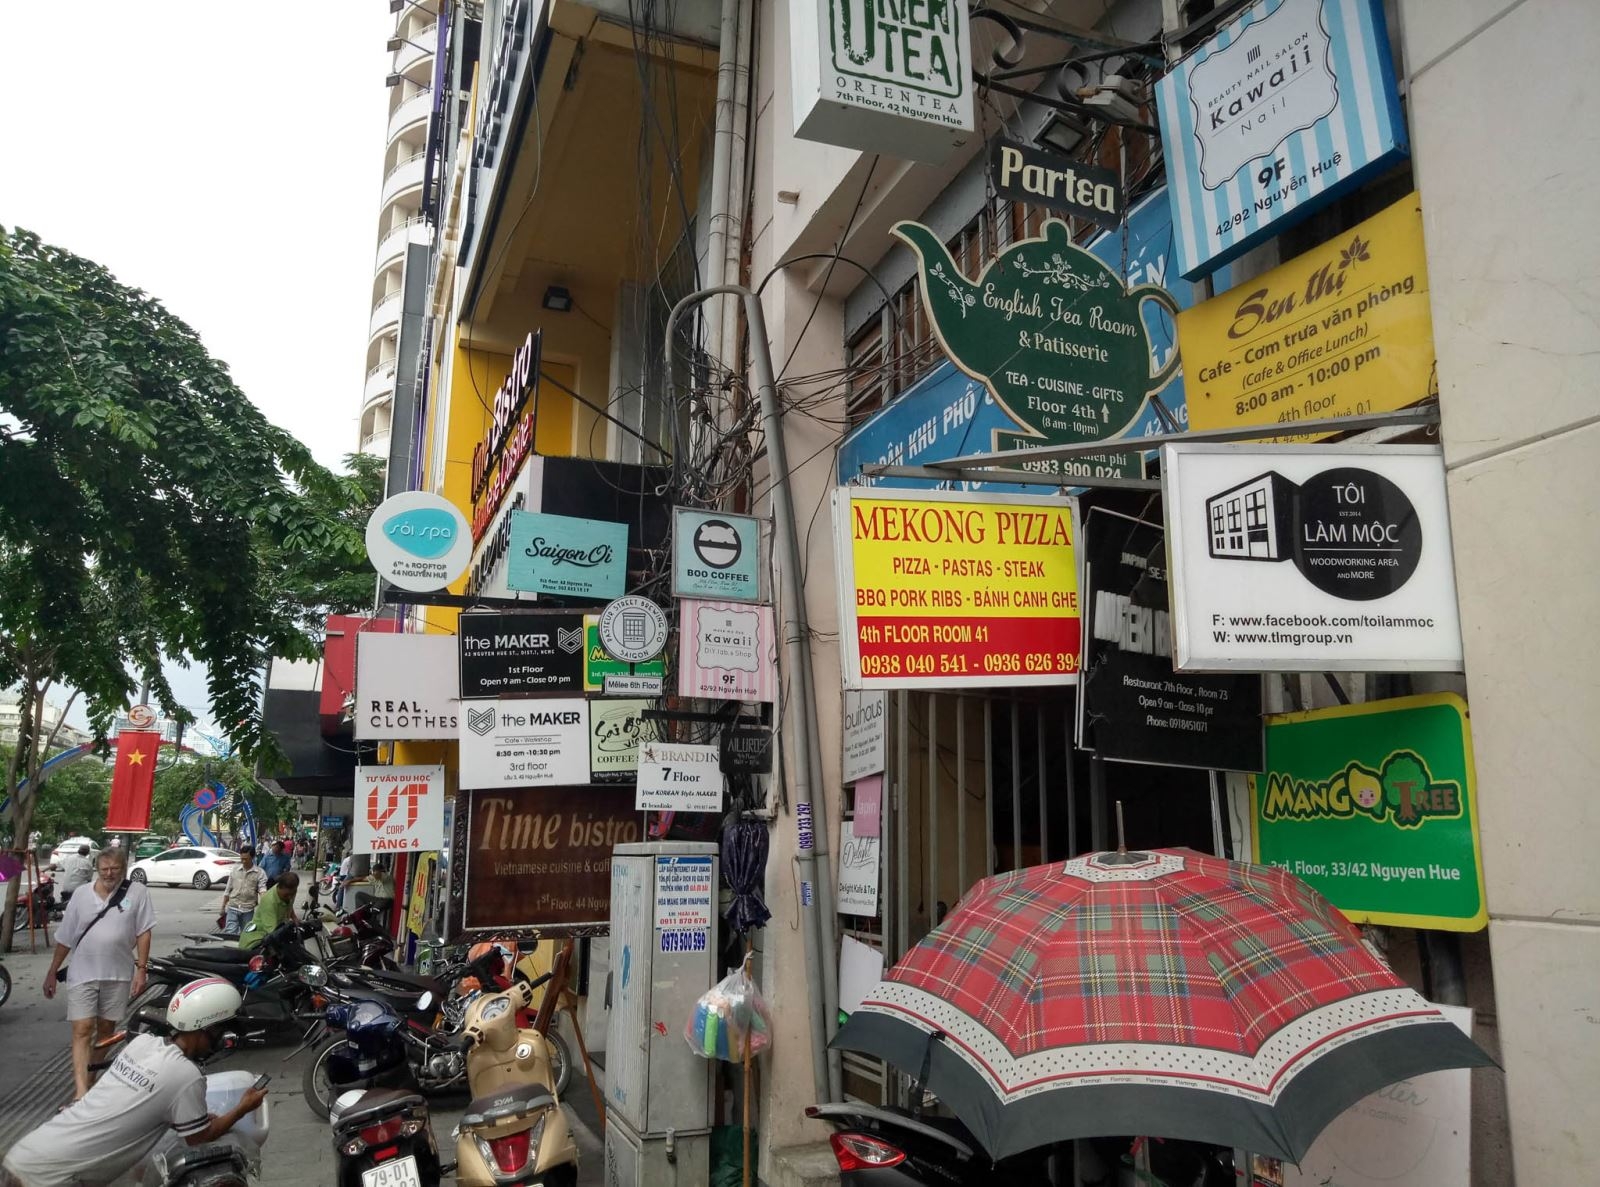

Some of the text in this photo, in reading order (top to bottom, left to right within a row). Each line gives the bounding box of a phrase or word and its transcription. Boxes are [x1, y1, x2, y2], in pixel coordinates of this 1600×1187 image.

[877, 22, 953, 87] TEA
[1208, 32, 1309, 108] BEAUTY NAIL SALON
[836, 77, 959, 115] ORIENTEA
[1210, 44, 1312, 131] Kawaii
[836, 91, 962, 126] 7th Floor, 42 Nguyen Hue
[1240, 96, 1287, 136] Nail
[1001, 146, 1115, 214] Partea
[1258, 158, 1286, 189] 9F
[1215, 151, 1342, 238] 42/92 Nguyễn Huệ
[982, 282, 1137, 338] English Tea Room
[1227, 288, 1297, 341] Sen
[1199, 274, 1415, 383] Cafe Cơm trưa văn phòng
[1019, 330, 1109, 363] & Patisserie
[1242, 322, 1369, 390] (Cafe & Office Lunch)
[1005, 370, 1125, 403] TEA CUISINE GIFTS
[1235, 344, 1381, 416] 8:00 am 10:00 pm
[1027, 395, 1096, 420] Floor 4th
[1278, 407, 1301, 423] 4th
[1304, 393, 1337, 416] floor
[908, 416, 937, 460] KHU
[1064, 460, 1091, 478] 900
[1332, 482, 1365, 505] TÔI
[419, 526, 452, 541] spa
[854, 505, 1072, 547] MEKONG PIZZA
[1304, 519, 1400, 548] LÀM MỘC
[525, 536, 589, 567] Saigon
[411, 562, 447, 570] ROOFTOP
[893, 557, 1046, 578] PIZZA PASTAS STEAK
[1310, 557, 1400, 567] WOODWORKING AREA
[687, 568, 709, 579] BOO
[711, 571, 750, 583] COFFEE
[856, 588, 886, 607] BBQ
[890, 589, 927, 607] PORK
[931, 590, 963, 607] RIBS
[974, 586, 1010, 608] BÁNH
[1013, 591, 1048, 609] CANH
[603, 599, 665, 643] PASTEUR STREET BREWING
[1212, 614, 1435, 628] F: www.facebook.com/toilammoc
[463, 634, 551, 650] the MAKER
[705, 633, 752, 646] Kawaii
[860, 625, 989, 643] 4th FLOOR ROOM 41
[1213, 630, 1354, 648] W: www.tlmgroup.vn
[619, 649, 650, 659] SAIGON
[508, 665, 544, 674] 1st Floor
[861, 654, 900, 675] 0938
[905, 654, 935, 674] 040
[940, 654, 968, 673] 541
[983, 653, 1021, 672] 0936
[1025, 653, 1052, 672] 626
[480, 678, 502, 687] Open
[502, 677, 509, 685] 9
[526, 676, 547, 684] Close
[547, 675, 558, 683] 09
[558, 676, 571, 684] pm
[641, 681, 660, 689] Floor
[722, 675, 736, 684] 9F
[371, 700, 428, 712] REAL.
[1138, 694, 1157, 709] Open
[370, 714, 458, 728] CLOTHES
[501, 711, 581, 727] the MAKER
[548, 749, 561, 757] pm
[597, 754, 635, 763] COFFEE
[510, 761, 548, 771] 3rd floor
[662, 767, 701, 782] 7 Floor
[413, 774, 431, 783] HỌC
[655, 789, 680, 797] KOREAN
[386, 824, 405, 835] CORP
[479, 797, 638, 851] Time bistro
[797, 817, 812, 831] 233
[411, 838, 419, 849] 4
[494, 859, 592, 876] Vietnamese cuisine &
[1295, 860, 1461, 883] Floor, 33/42 Nguyen Hue
[839, 882, 854, 895] Delight
[551, 897, 586, 911] Floor, 44
